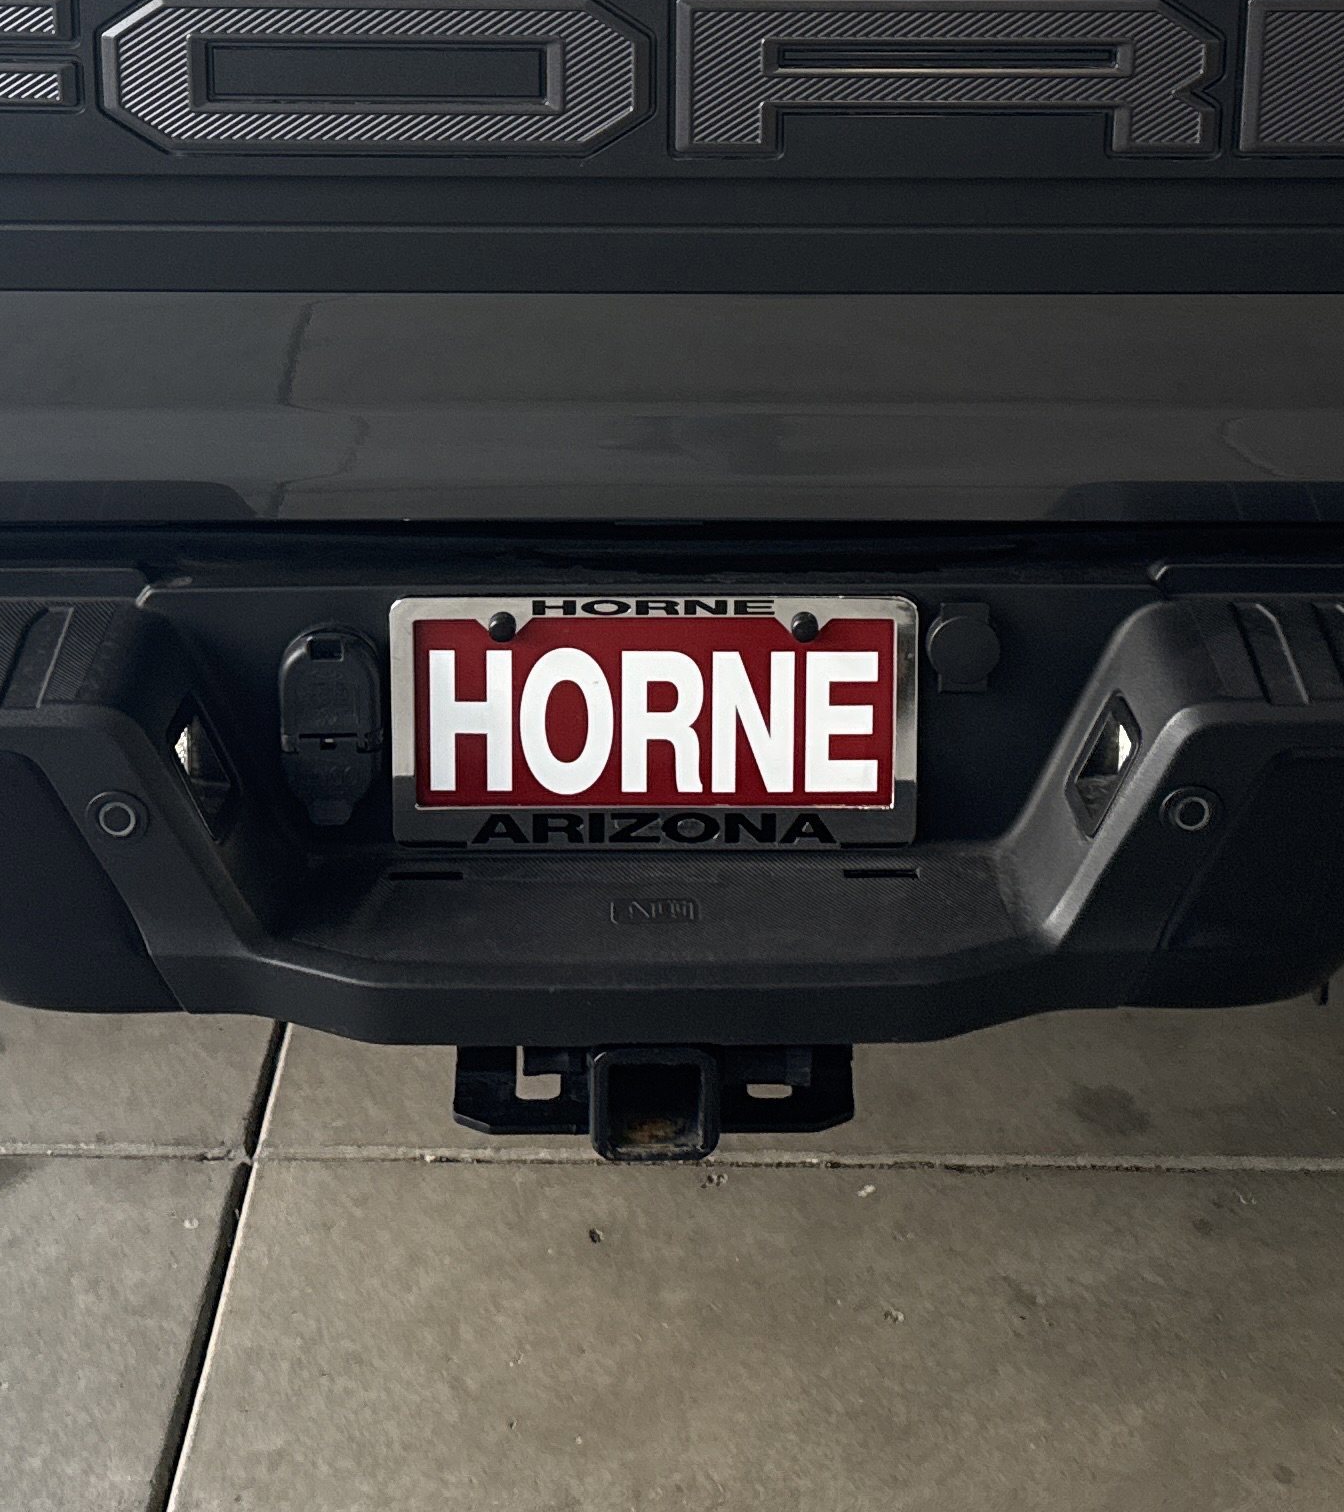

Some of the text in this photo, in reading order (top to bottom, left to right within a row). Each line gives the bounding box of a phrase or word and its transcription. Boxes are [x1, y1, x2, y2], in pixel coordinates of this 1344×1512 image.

[531, 599, 775, 616] HORNE
[428, 647, 879, 795] HORNE
[471, 812, 838, 845] ARIZONA
